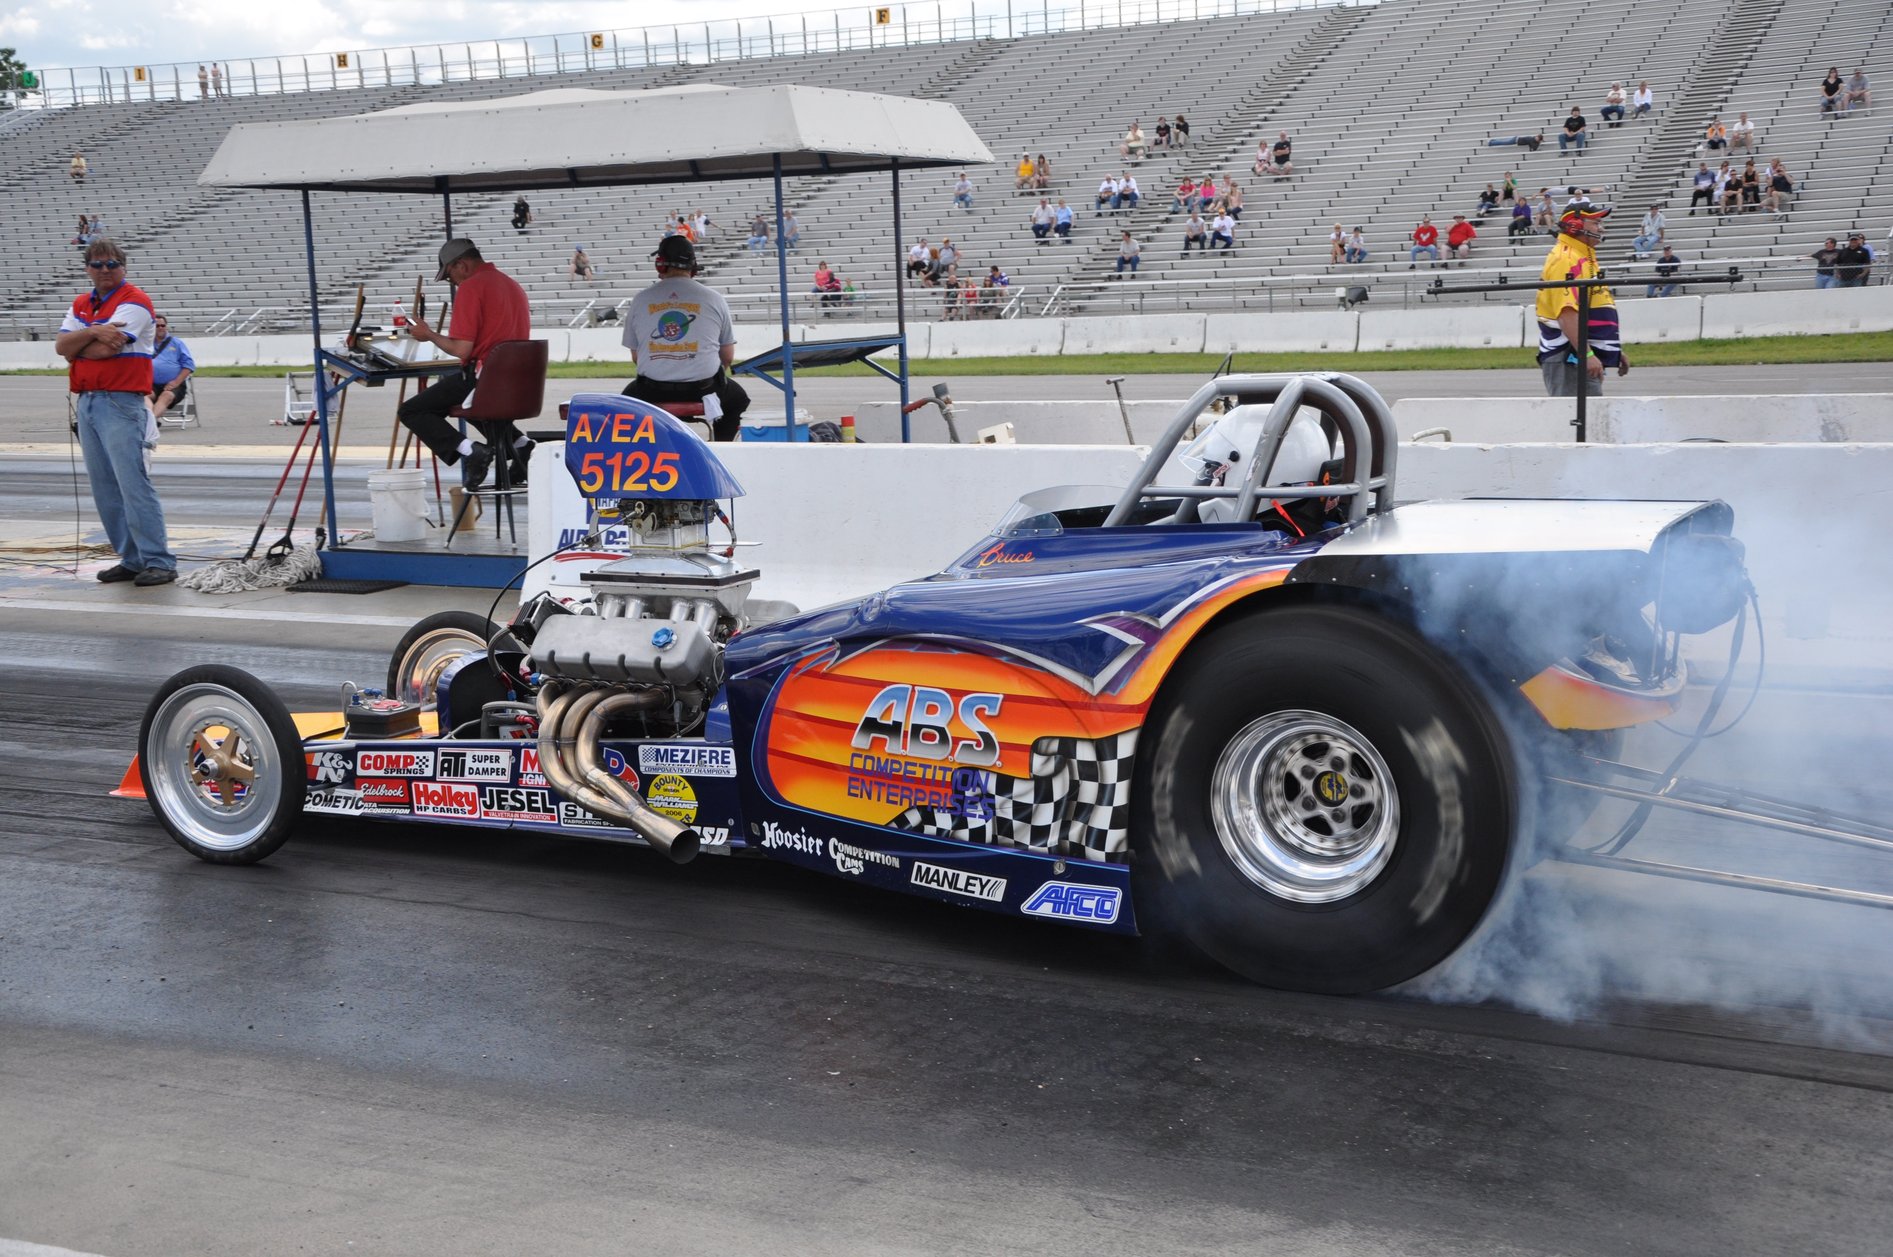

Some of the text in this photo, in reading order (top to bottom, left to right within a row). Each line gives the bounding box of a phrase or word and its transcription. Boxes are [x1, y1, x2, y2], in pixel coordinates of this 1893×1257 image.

[591, 35, 602, 47] G
[337, 54, 347, 67] H
[571, 413, 656, 443] A/EA
[579, 451, 680, 493] 5125
[977, 542, 1035, 568] Bruce
[360, 754, 415, 771] COMP
[440, 752, 466, 777] ATI
[471, 754, 500, 764] SUPER
[656, 748, 731, 765] MEZIERE
[468, 767, 507, 776] DAMPER
[849, 752, 990, 794] COMPETITION
[360, 783, 405, 798] Edelbrock
[654, 775, 688, 791] BOUNTY
[304, 792, 364, 810] COMETIC
[413, 783, 478, 815] Holley
[482, 788, 556, 814] JESEL
[652, 800, 697, 809] WILLIAMS
[847, 776, 995, 821] ENTERPRISES
[416, 805, 467, 815] HP CARBS
[564, 818, 602, 826] FABRICATION
[761, 821, 823, 856] Hoosier
[914, 865, 990, 896] MANLEY
[1026, 885, 1118, 919] AFCO
